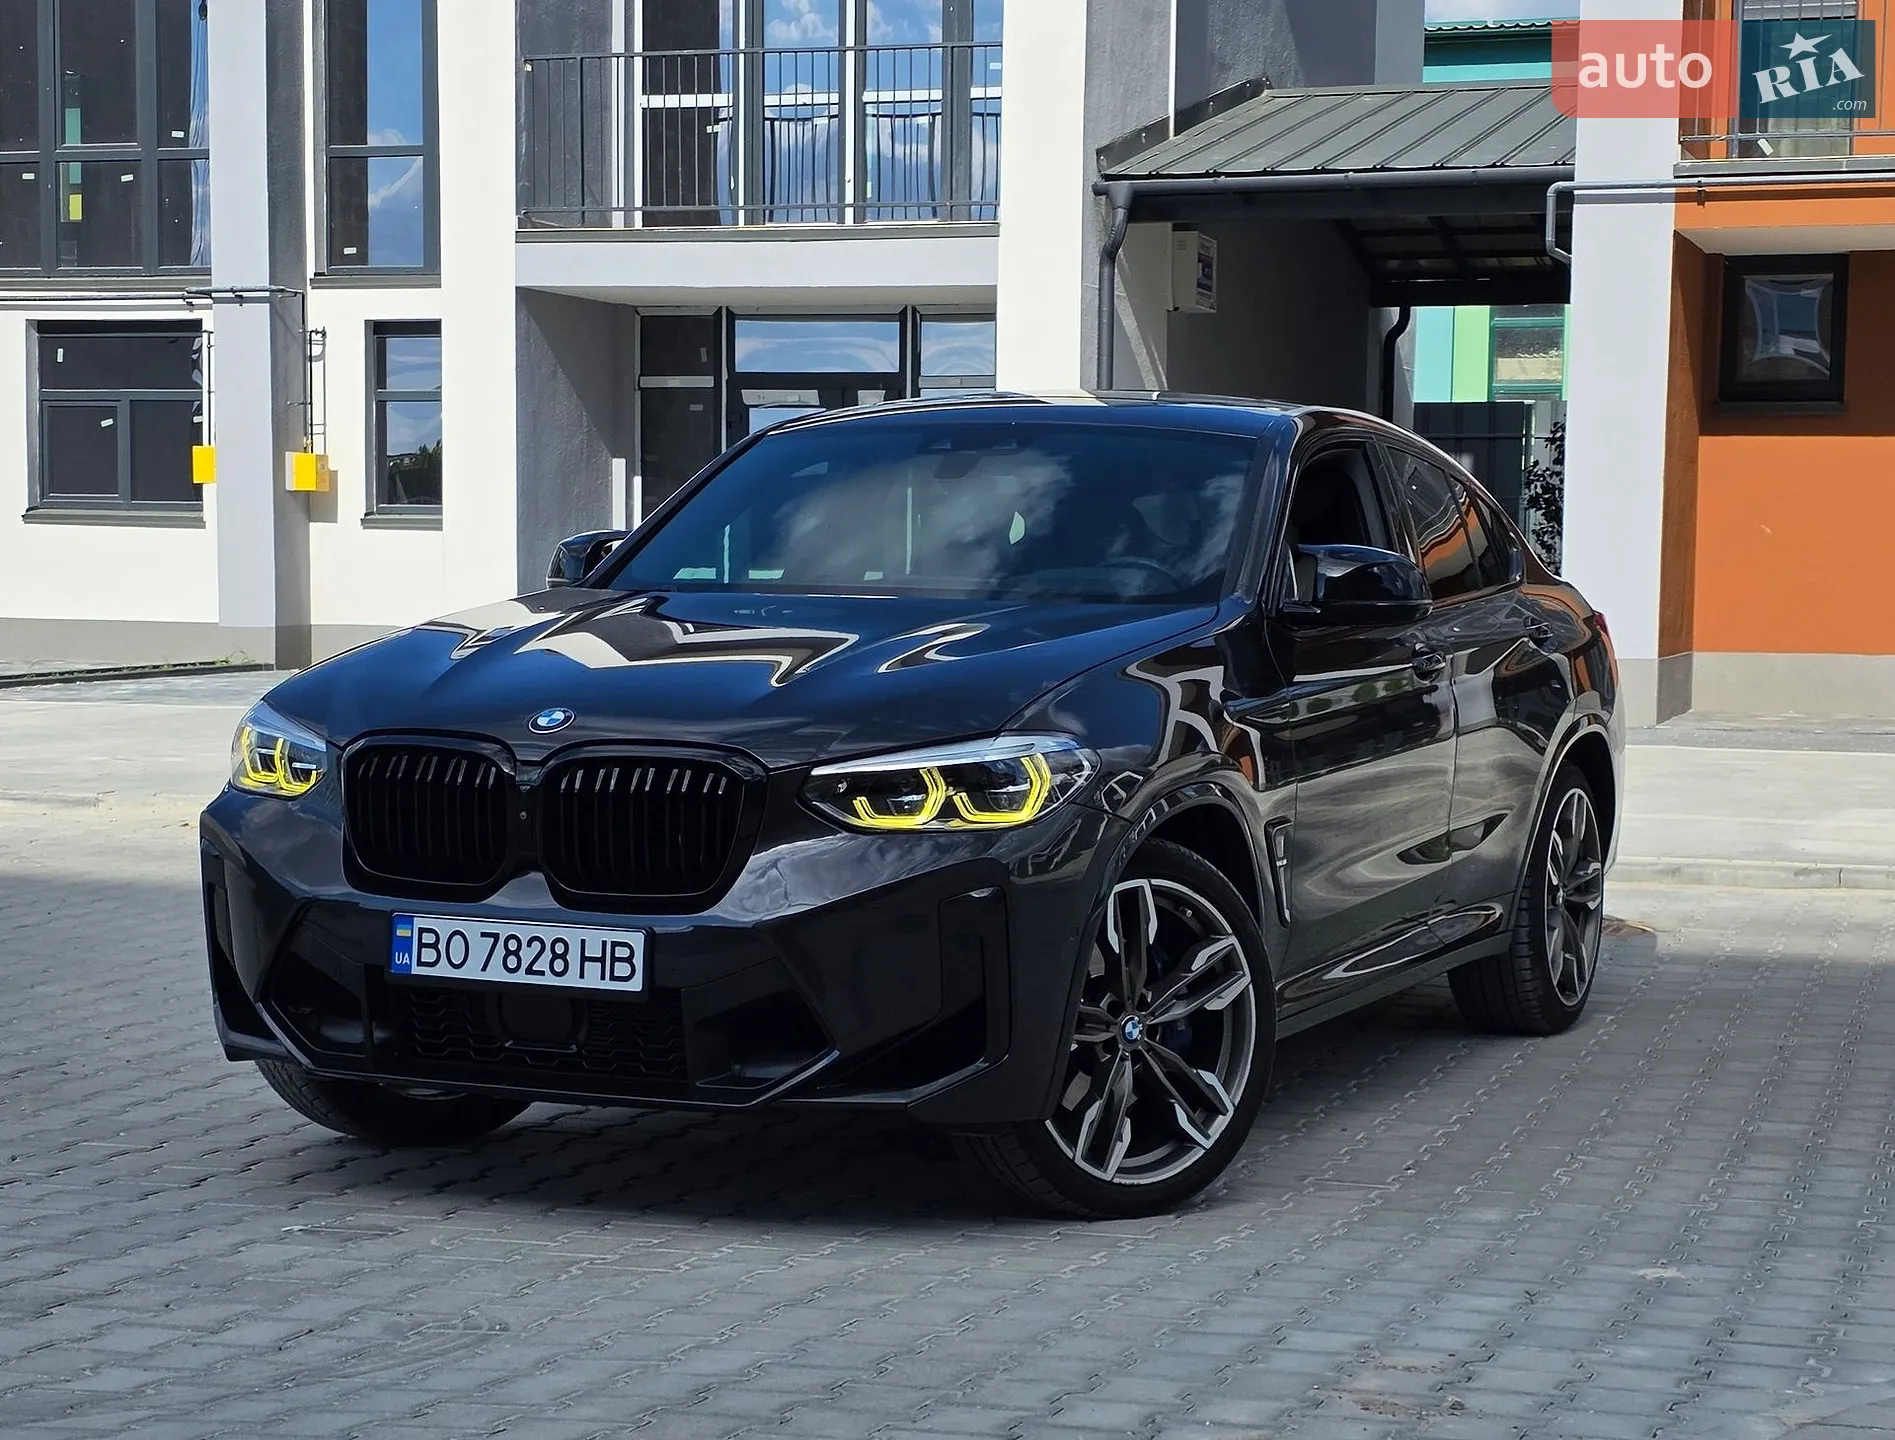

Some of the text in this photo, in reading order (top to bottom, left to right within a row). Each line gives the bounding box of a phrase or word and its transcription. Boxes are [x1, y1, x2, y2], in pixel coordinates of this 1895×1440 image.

[395, 951, 410, 965] UA
[416, 926, 637, 983] BO 7828 HB
